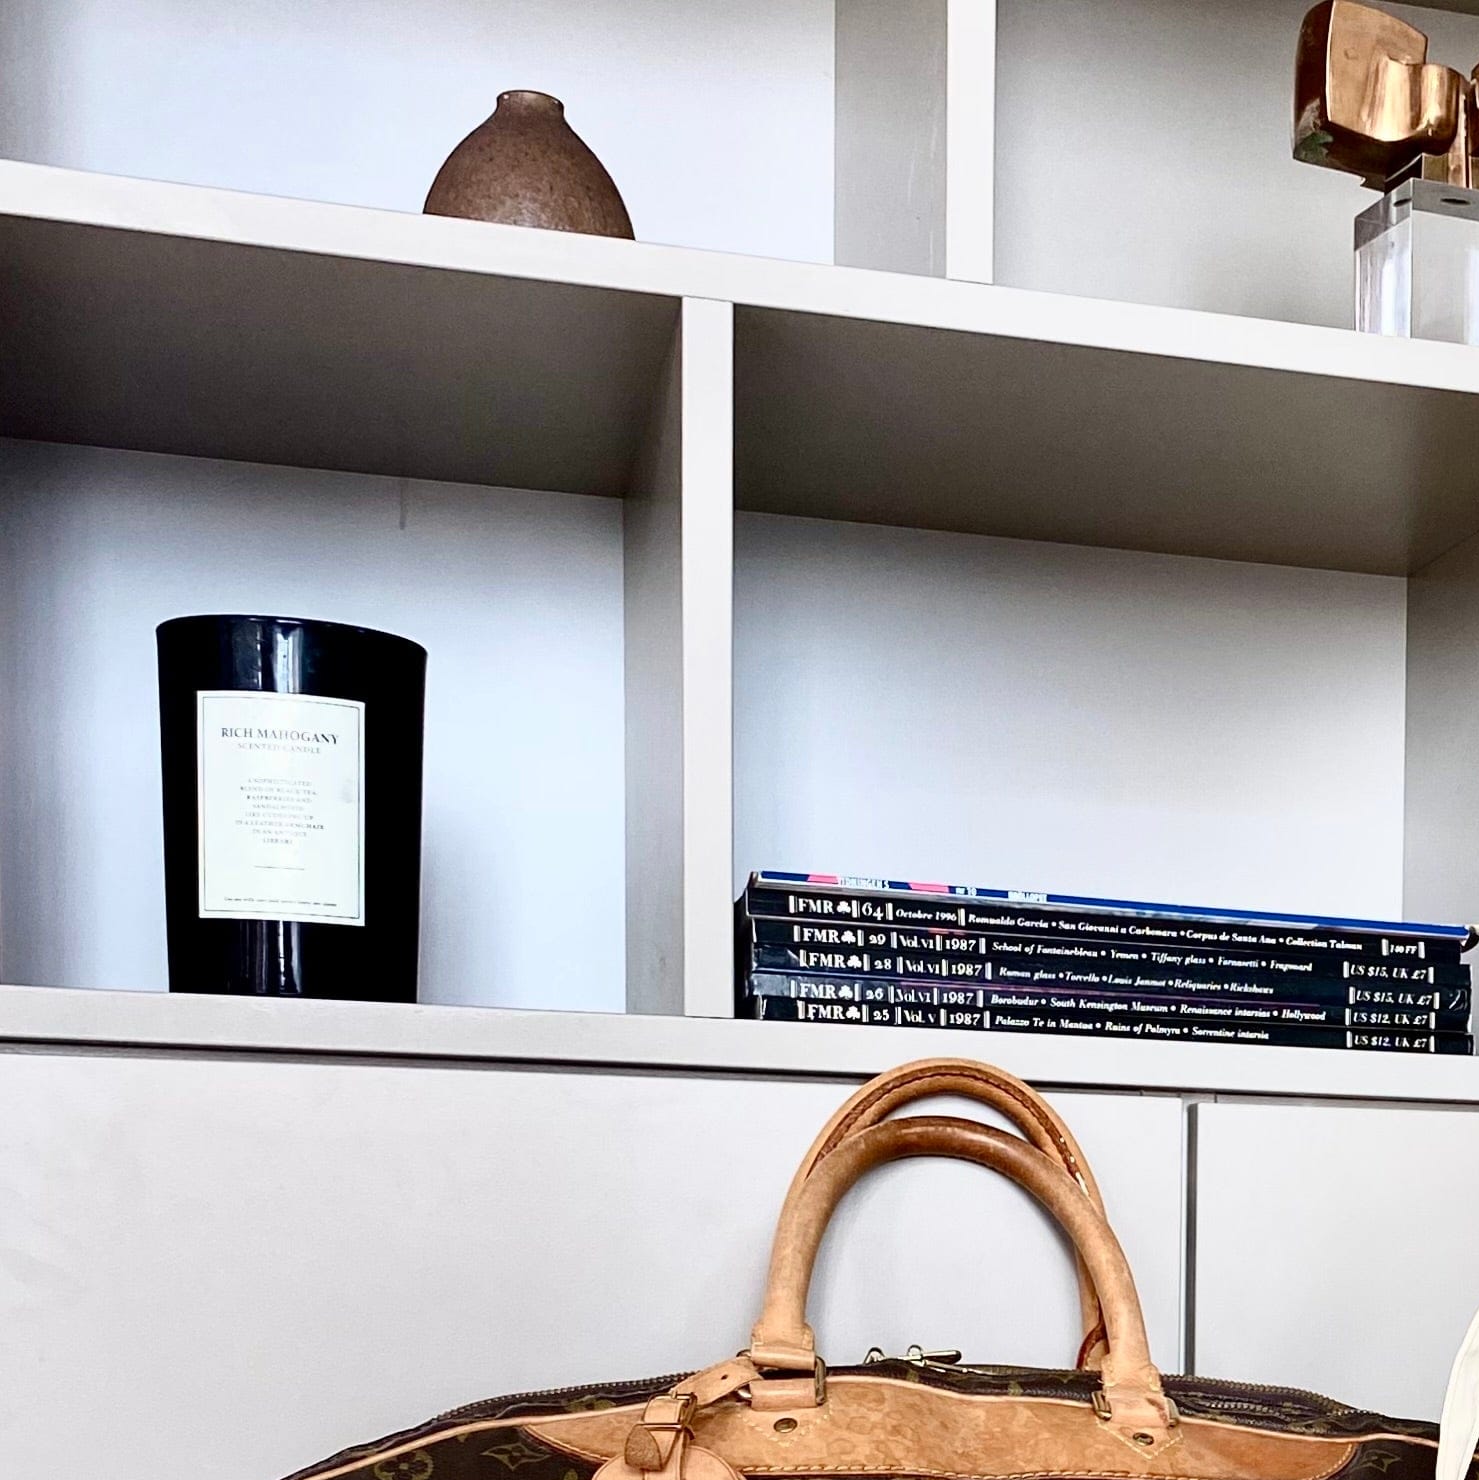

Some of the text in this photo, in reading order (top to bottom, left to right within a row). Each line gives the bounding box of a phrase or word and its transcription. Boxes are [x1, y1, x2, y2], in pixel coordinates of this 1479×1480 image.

[220, 727, 339, 745] RICH MAHOGANY
[798, 898, 835, 915] FMR
[861, 902, 884, 920] 64
[895, 908, 933, 920] Octobre
[968, 914, 1016, 926] Romualdo
[1058, 921, 1076, 931] San
[1186, 930, 1218, 942] Corpus
[1218, 931, 1231, 941] de
[1231, 932, 1257, 944] Santa
[1258, 935, 1277, 944] Ana
[1285, 936, 1328, 948] Collection
[802, 928, 841, 944] FMR
[868, 934, 886, 945] 29
[945, 939, 977, 952] 1987
[991, 941, 1022, 953] School
[1024, 944, 1035, 955] of
[1110, 950, 1139, 961] Yemen
[1151, 952, 1183, 965] Tiffany
[1184, 954, 1206, 965] glass
[1350, 964, 1366, 976] US
[1392, 967, 1408, 979] UK
[1411, 969, 1427, 980] £7
[808, 952, 847, 969] FMR
[874, 958, 892, 970] 28
[951, 963, 983, 976] 1987
[999, 967, 1031, 978] Roman
[1033, 970, 1056, 981] glass
[1107, 974, 1133, 985] Louis
[1174, 979, 1222, 992] Reliquaries
[1356, 990, 1372, 1002] US
[1398, 993, 1414, 1005] UK
[1416, 995, 1433, 1006] £7
[800, 983, 838, 999] FMR
[865, 988, 884, 1000] 26
[942, 992, 974, 1005] 1987
[990, 994, 1039, 1006] Borobudur
[1050, 997, 1076, 1008] South
[1078, 999, 1129, 1012] Kensington
[1131, 1001, 1169, 1013] Museum
[1180, 1004, 1233, 1017] Renaissance
[1281, 1009, 1326, 1022] Hollywood
[1353, 1012, 1368, 1023] US
[1394, 1014, 1410, 1025] UK
[1412, 1015, 1428, 1025] £7
[807, 1003, 846, 1020] FMR
[873, 1009, 890, 1021] 25
[949, 1013, 981, 1026] 1987
[994, 1016, 1030, 1027] Palazzo
[1032, 1018, 1044, 1027] Te
[1047, 1018, 1056, 1028] in
[1059, 1019, 1094, 1030] Mantua
[1104, 1021, 1131, 1033] Ruins
[1132, 1023, 1145, 1035] of
[1145, 1024, 1181, 1037] Palmyra
[1191, 1026, 1236, 1038] Sorrentine
[1354, 1034, 1369, 1046] US
[1395, 1036, 1410, 1048] UK
[1412, 1038, 1428, 1048] £7
